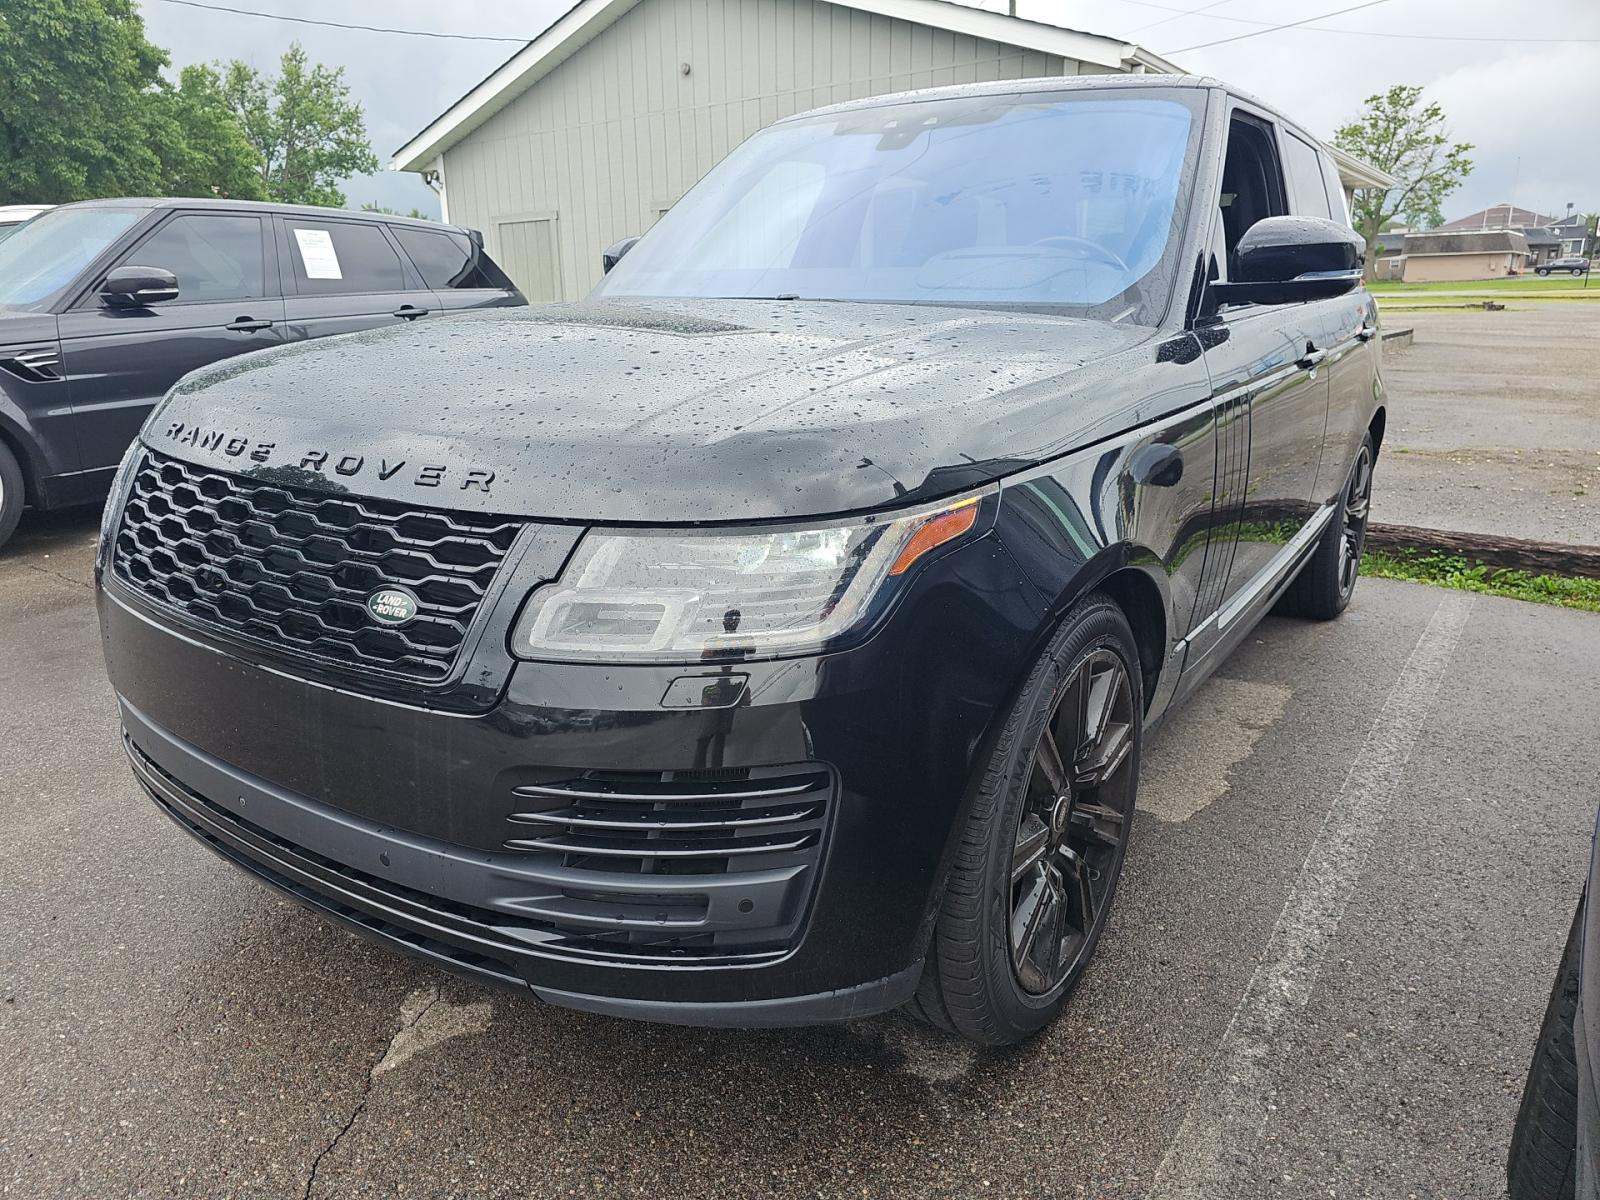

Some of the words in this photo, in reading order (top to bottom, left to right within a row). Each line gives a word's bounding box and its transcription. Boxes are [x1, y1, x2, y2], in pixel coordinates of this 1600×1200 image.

[166, 422, 276, 462] RANGE
[300, 448, 496, 492] ROVER
[377, 593, 402, 607] LAND
[376, 603, 408, 618] ROVER
